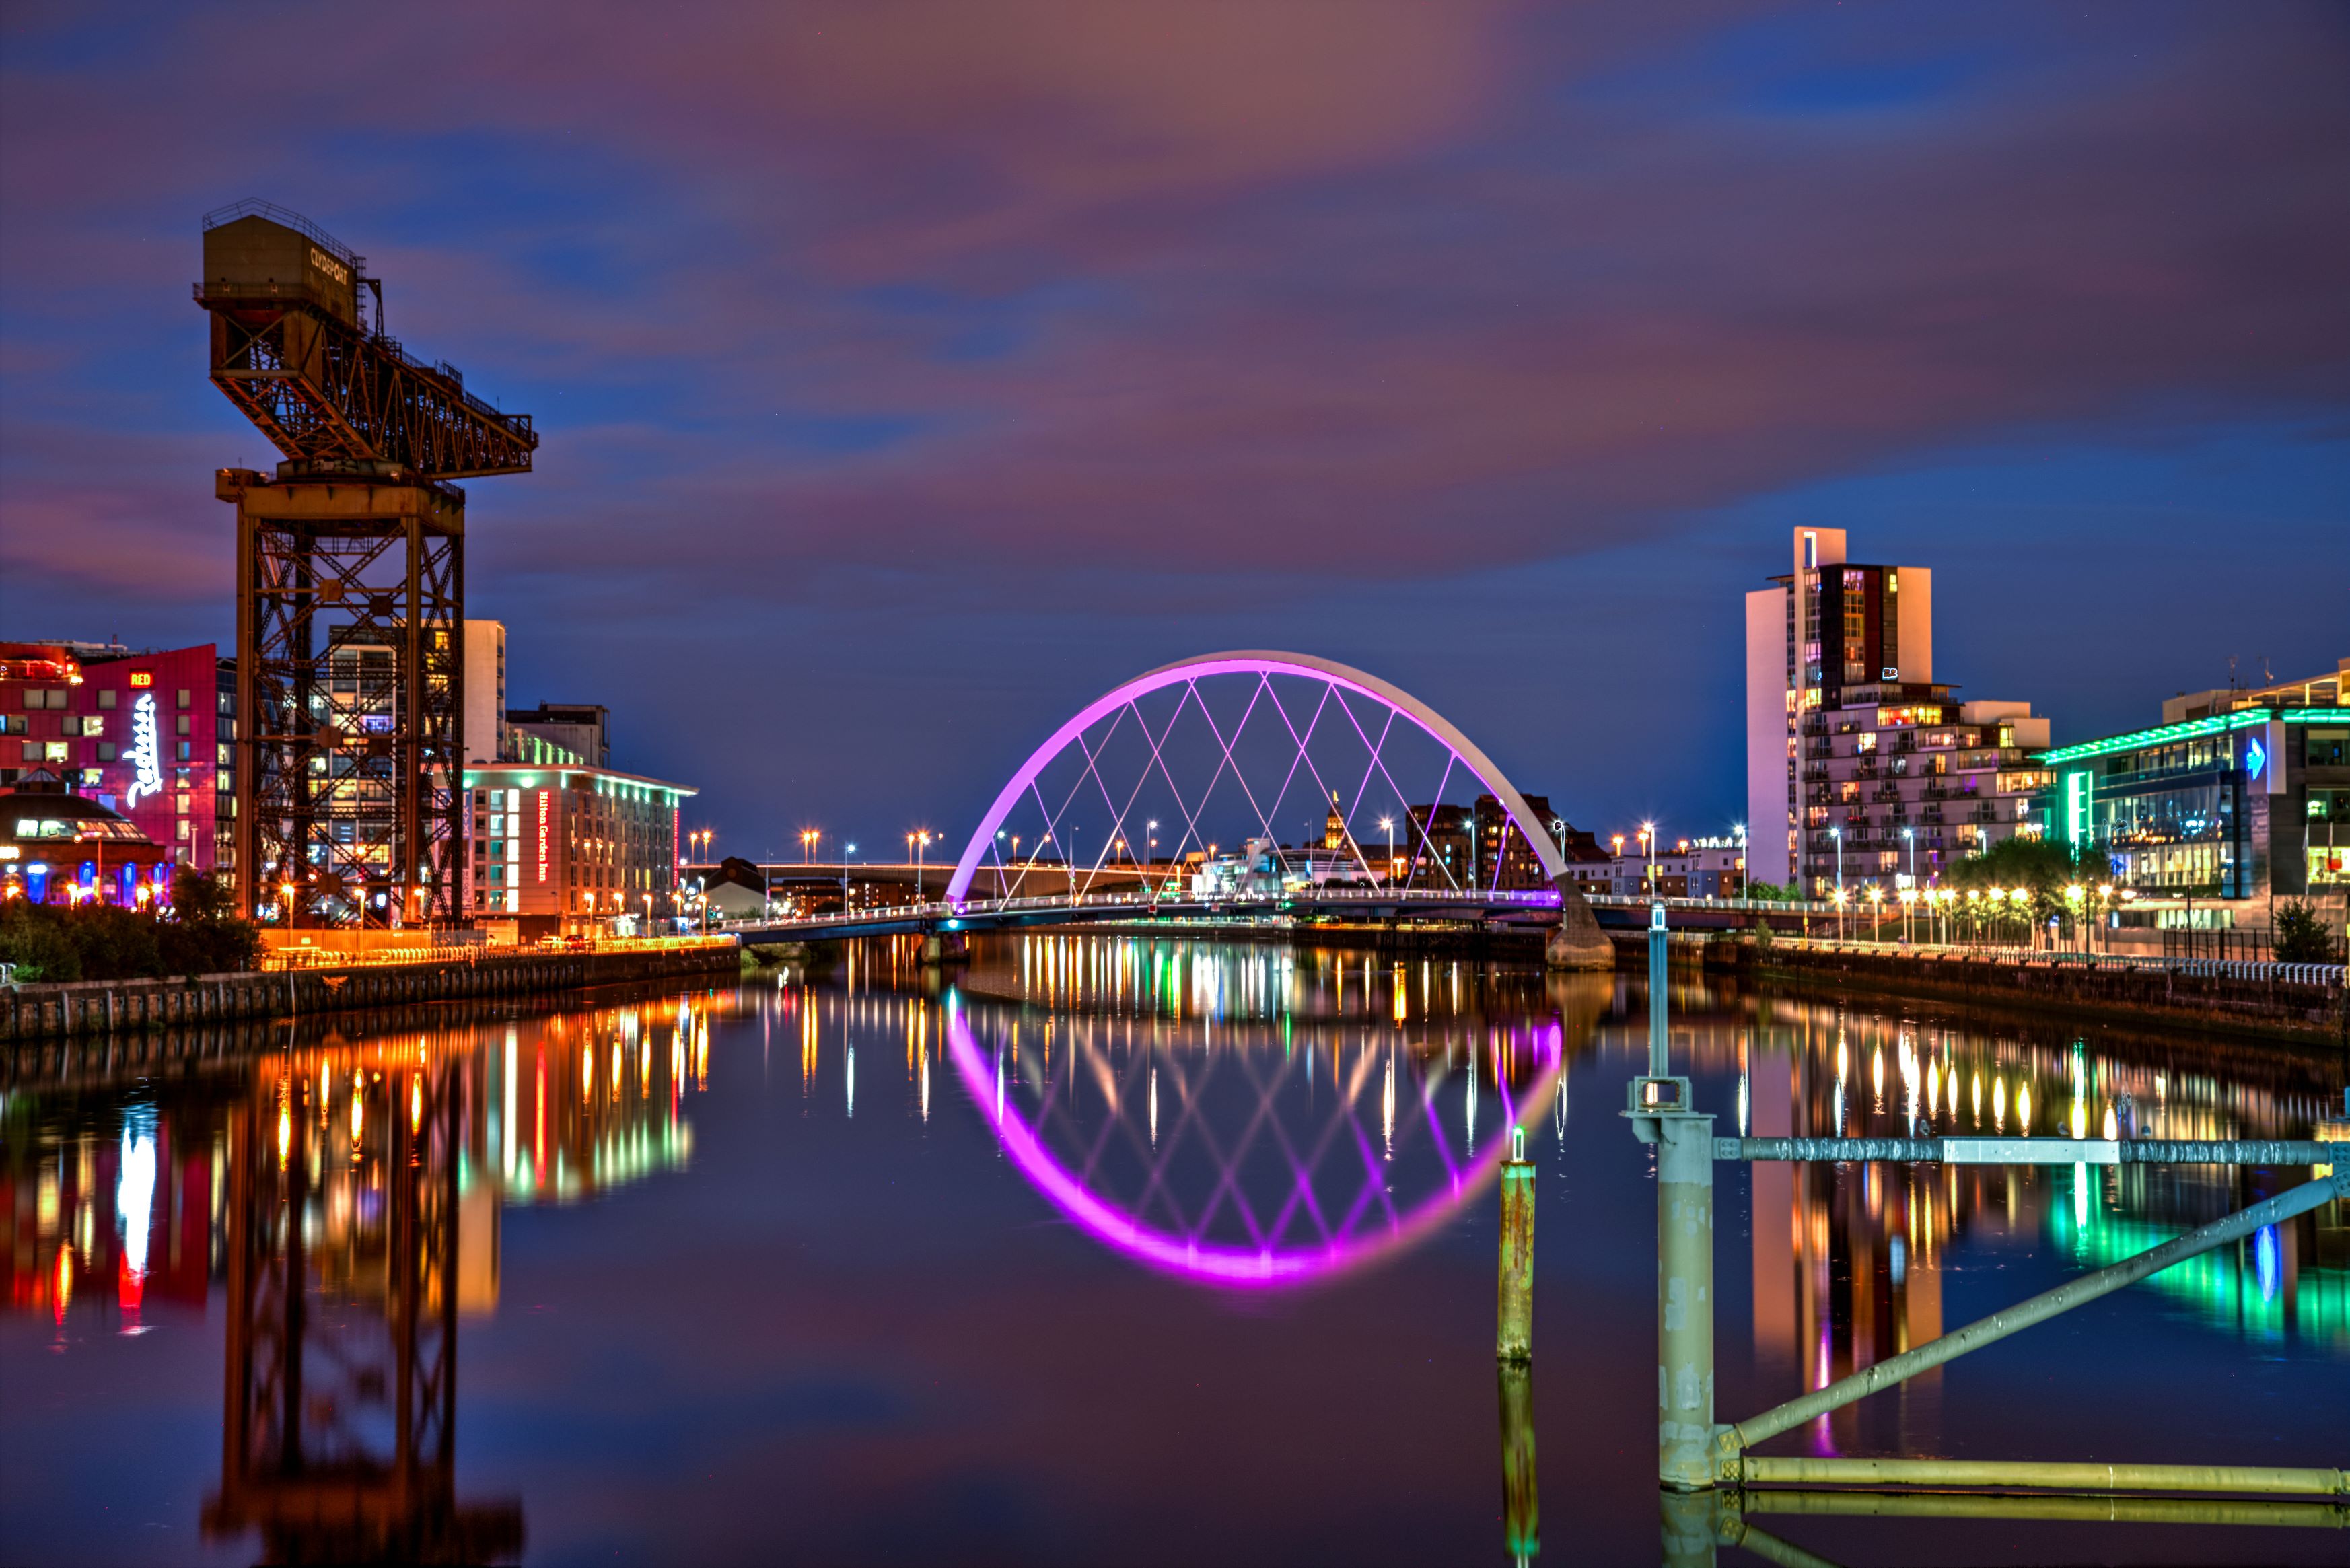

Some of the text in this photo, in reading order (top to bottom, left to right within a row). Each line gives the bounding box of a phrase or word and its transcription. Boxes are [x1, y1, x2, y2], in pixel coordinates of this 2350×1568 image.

[311, 248, 348, 285] CLYDEPORT
[131, 674, 151, 686] RED
[122, 694, 163, 809] Radisson
[539, 792, 548, 881] Hilton Garden Inn
